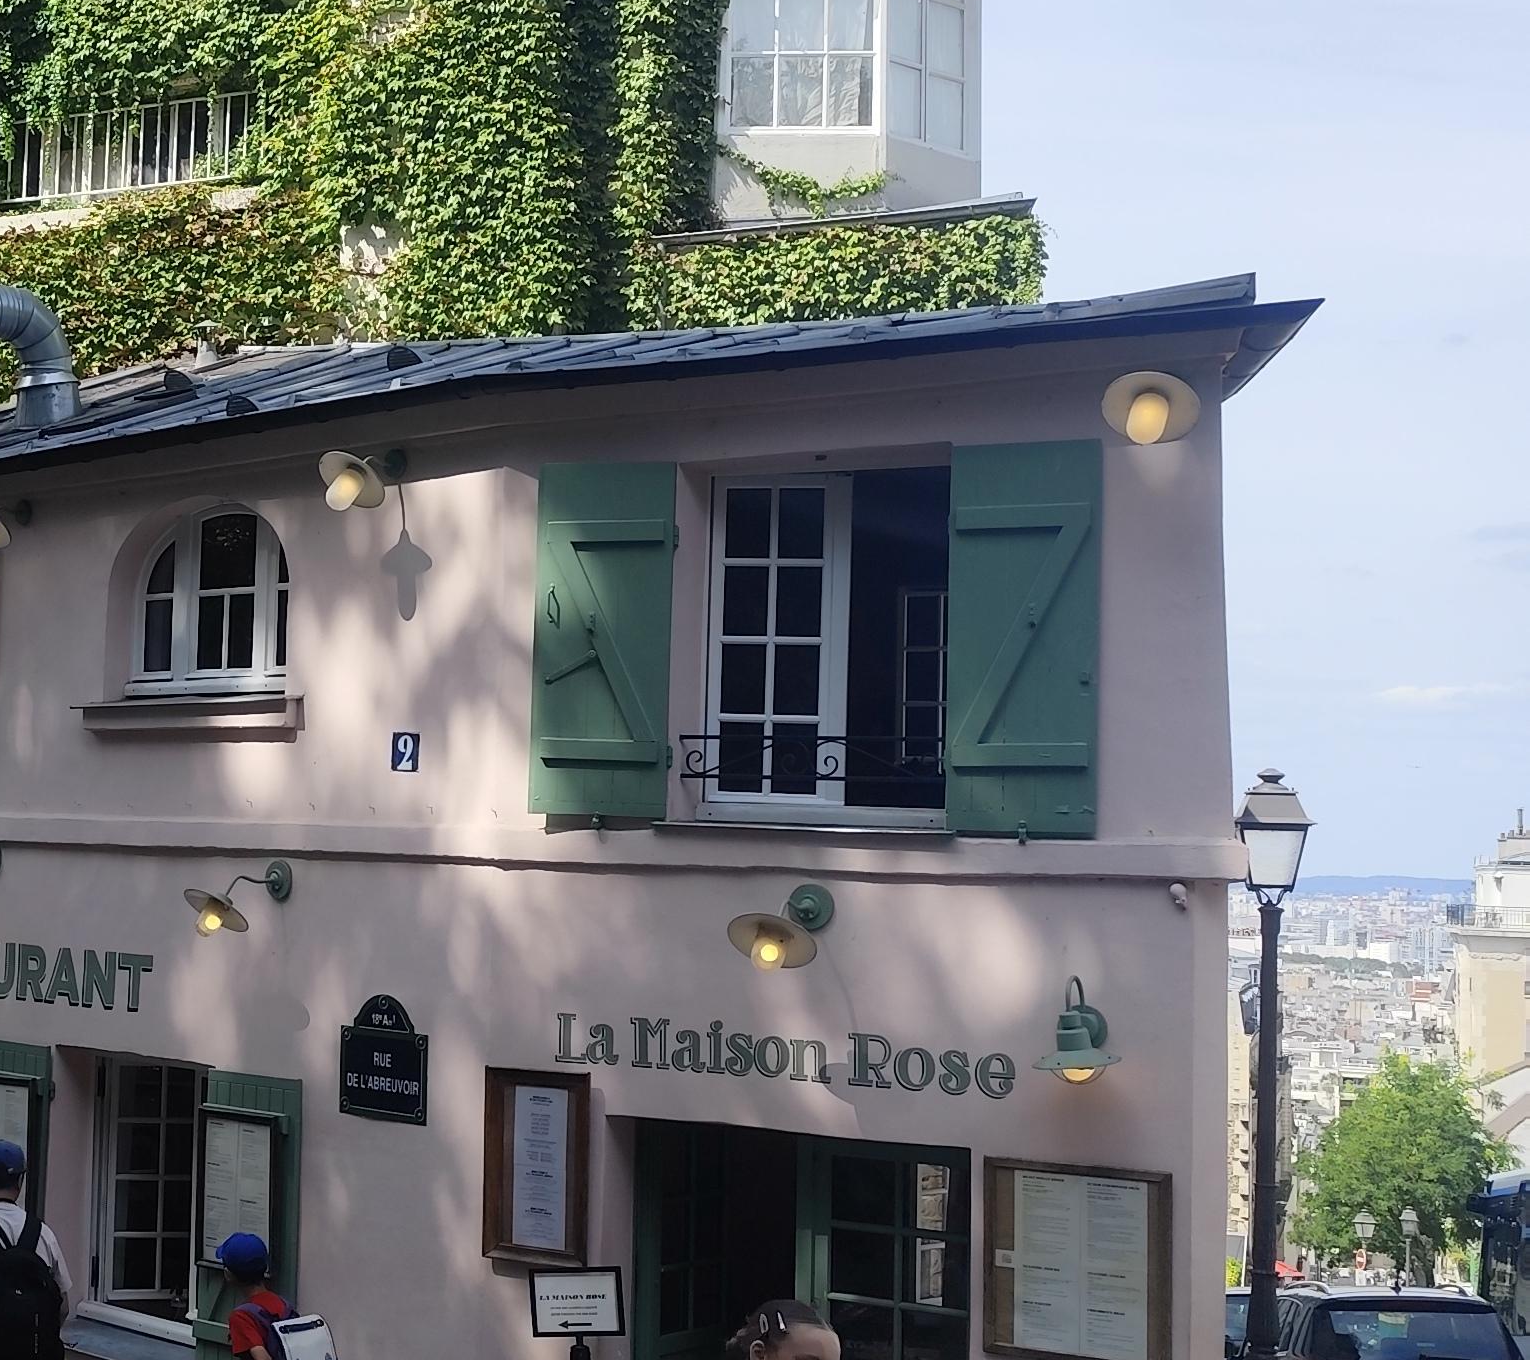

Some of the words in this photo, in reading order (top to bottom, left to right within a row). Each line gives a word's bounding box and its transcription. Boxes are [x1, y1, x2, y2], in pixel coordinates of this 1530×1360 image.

[396, 734, 413, 770] 2
[373, 1051, 392, 1068] RUE
[554, 1012, 620, 1066] La
[629, 1016, 832, 1084] Maison
[847, 1032, 1016, 1100] Rose
[346, 1072, 359, 1088] DE
[360, 1074, 420, 1096] L'ABREUVOIR
